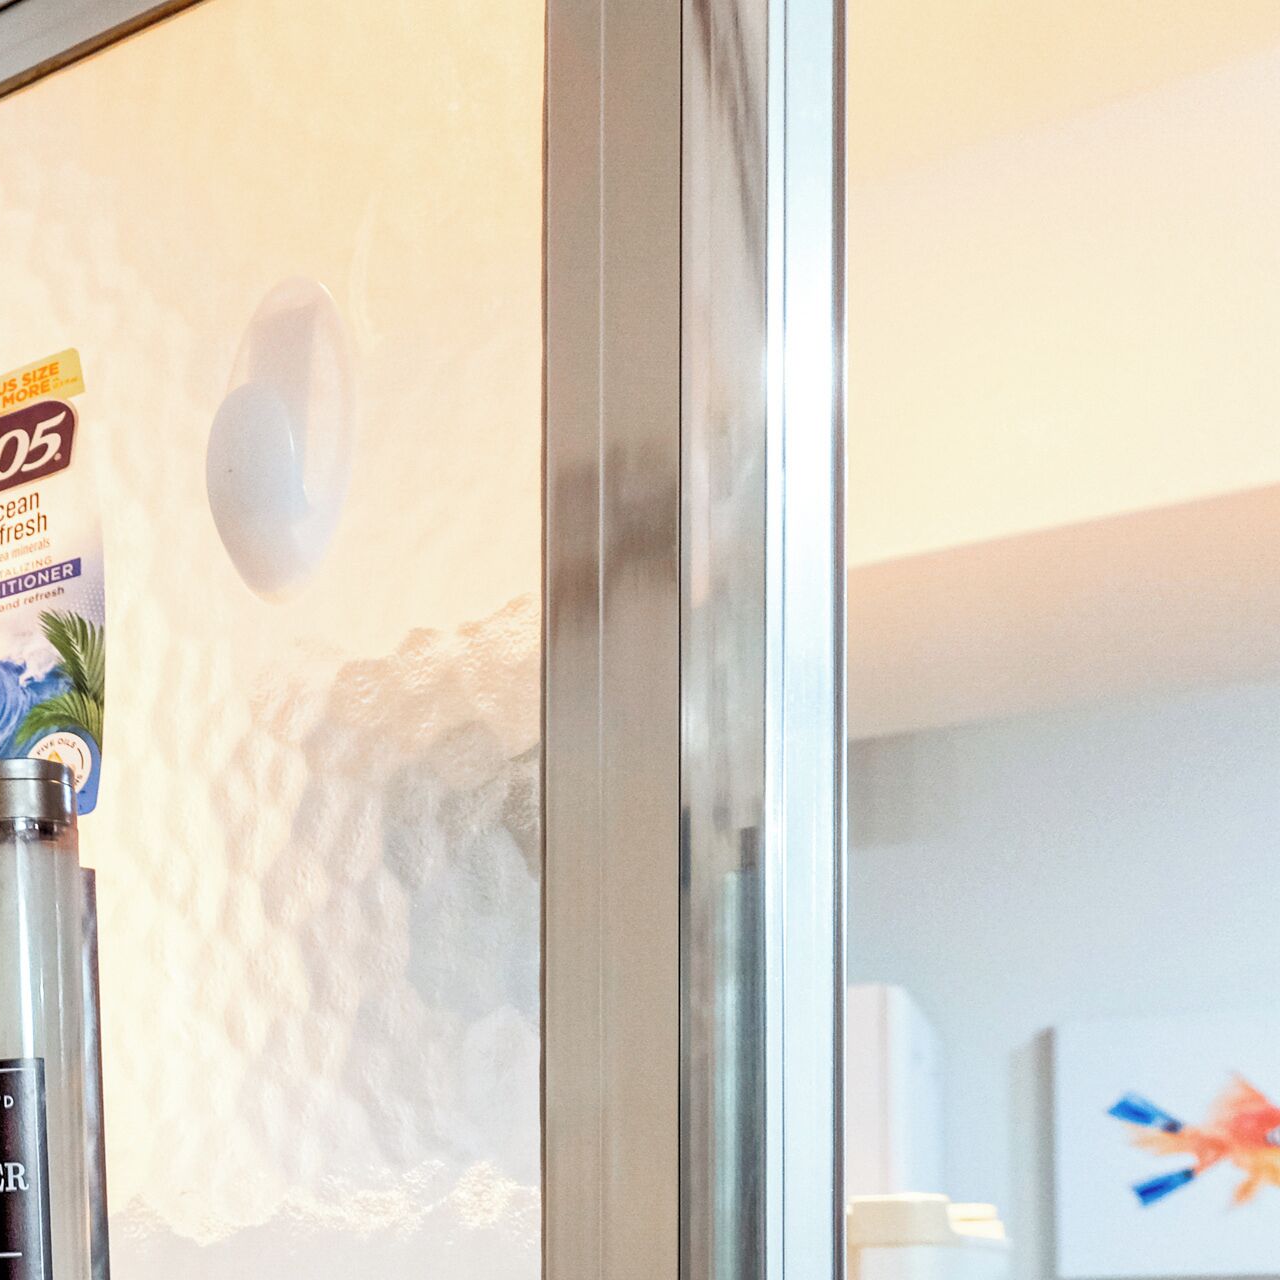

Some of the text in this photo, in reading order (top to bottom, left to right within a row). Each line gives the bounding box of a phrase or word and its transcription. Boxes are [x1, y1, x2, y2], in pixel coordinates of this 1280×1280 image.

[22, 361, 60, 387] SIZE
[2, 378, 51, 408] MORE
[11, 537, 51, 559] minerals
[0, 598, 20, 613] and
[23, 586, 65, 605] refresh
